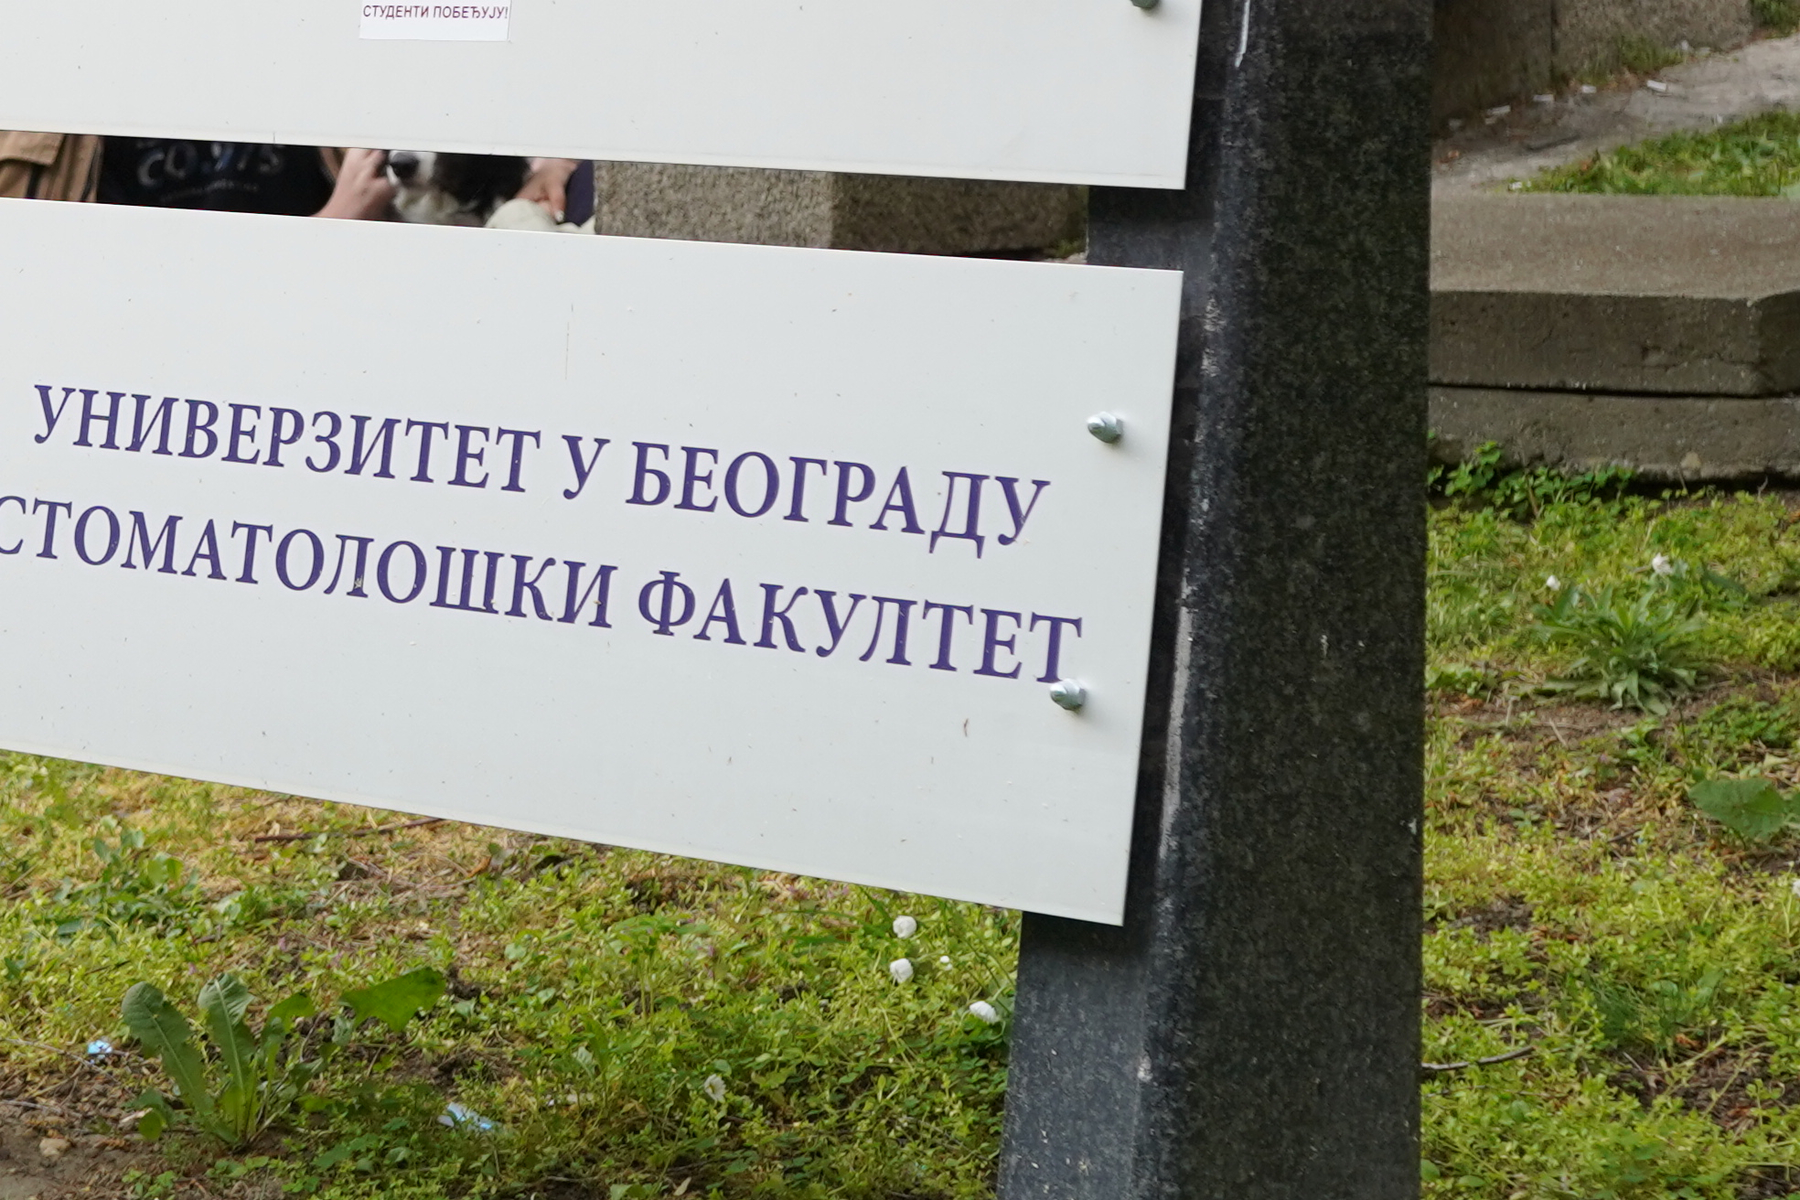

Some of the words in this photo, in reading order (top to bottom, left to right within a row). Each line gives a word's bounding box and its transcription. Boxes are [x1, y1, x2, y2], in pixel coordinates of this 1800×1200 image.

[362, 4, 429, 20] СТУДЕНТИ
[433, 5, 509, 20] ПОБЕЂУЈУ!
[33, 384, 542, 494] УНИВЕРЗИТЕТ
[561, 434, 612, 501] У
[625, 441, 1052, 560] БЕОГРАДУ
[637, 570, 1084, 685] ФАКУЛТЕТ
